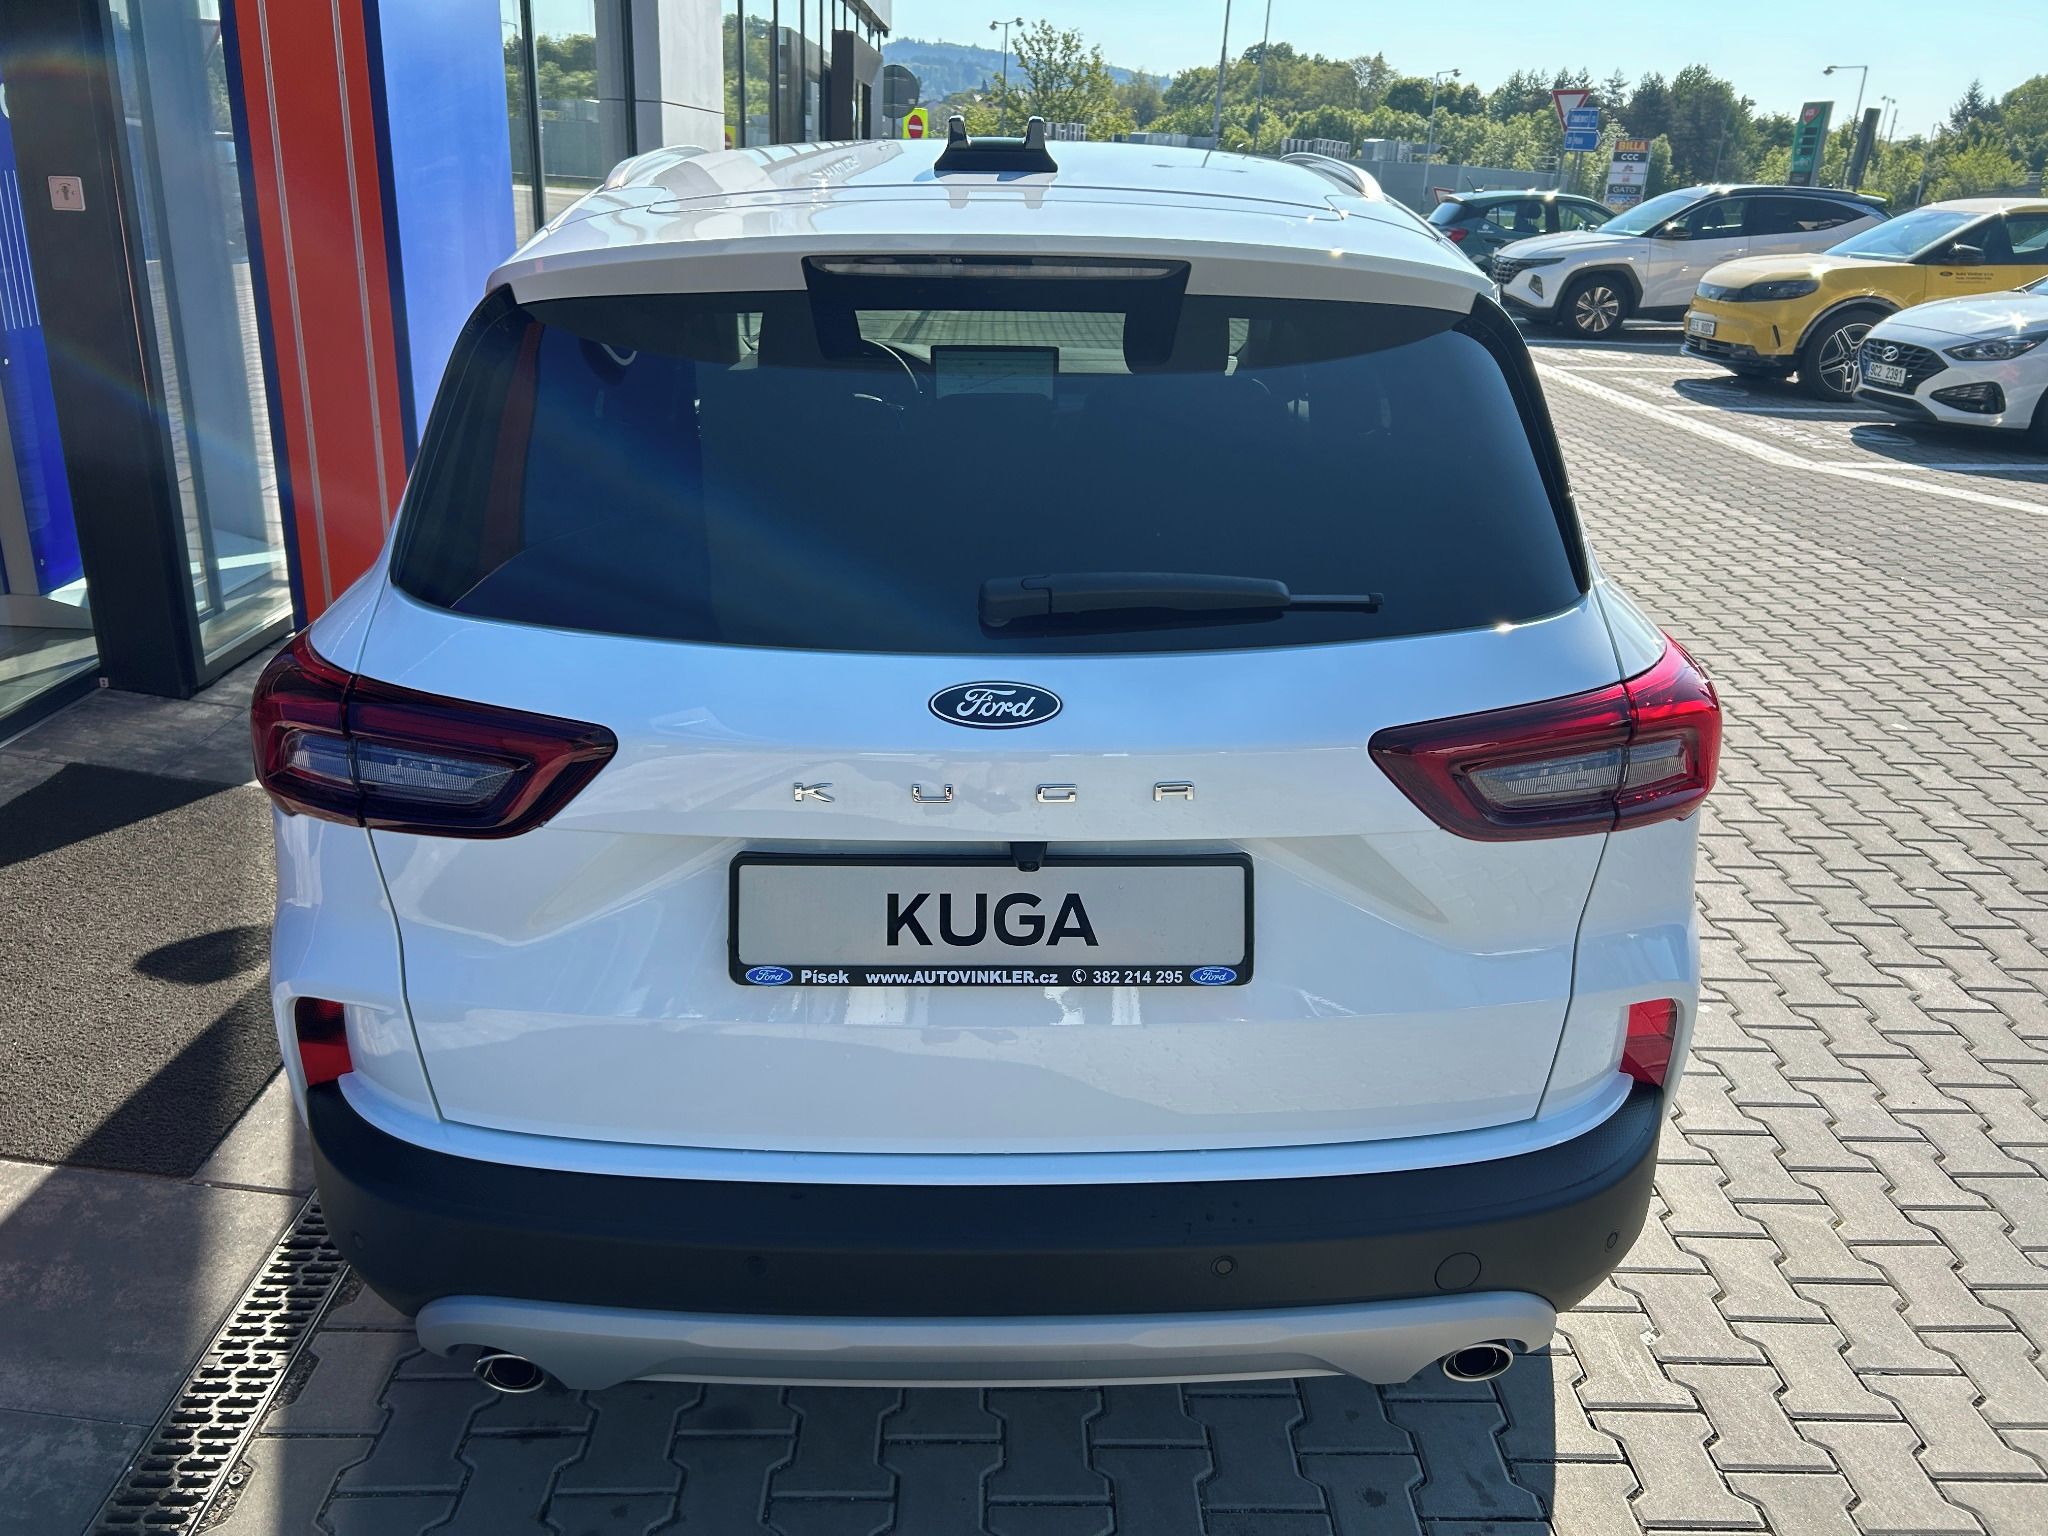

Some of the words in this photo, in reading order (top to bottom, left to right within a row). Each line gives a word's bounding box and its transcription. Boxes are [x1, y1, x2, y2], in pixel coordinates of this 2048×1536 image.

[1619, 141, 1646, 150] BILLA
[1885, 367, 1903, 380] 2391
[957, 688, 1036, 718] Ford
[794, 781, 1195, 803] KUGA
[886, 893, 1099, 946] KUGA
[801, 969, 849, 984] Písek
[866, 970, 1058, 984] www.AUTOVINKLER.cz
[1093, 970, 1120, 984] 382
[1124, 970, 1151, 984] 214
[1156, 970, 1183, 984] 295
